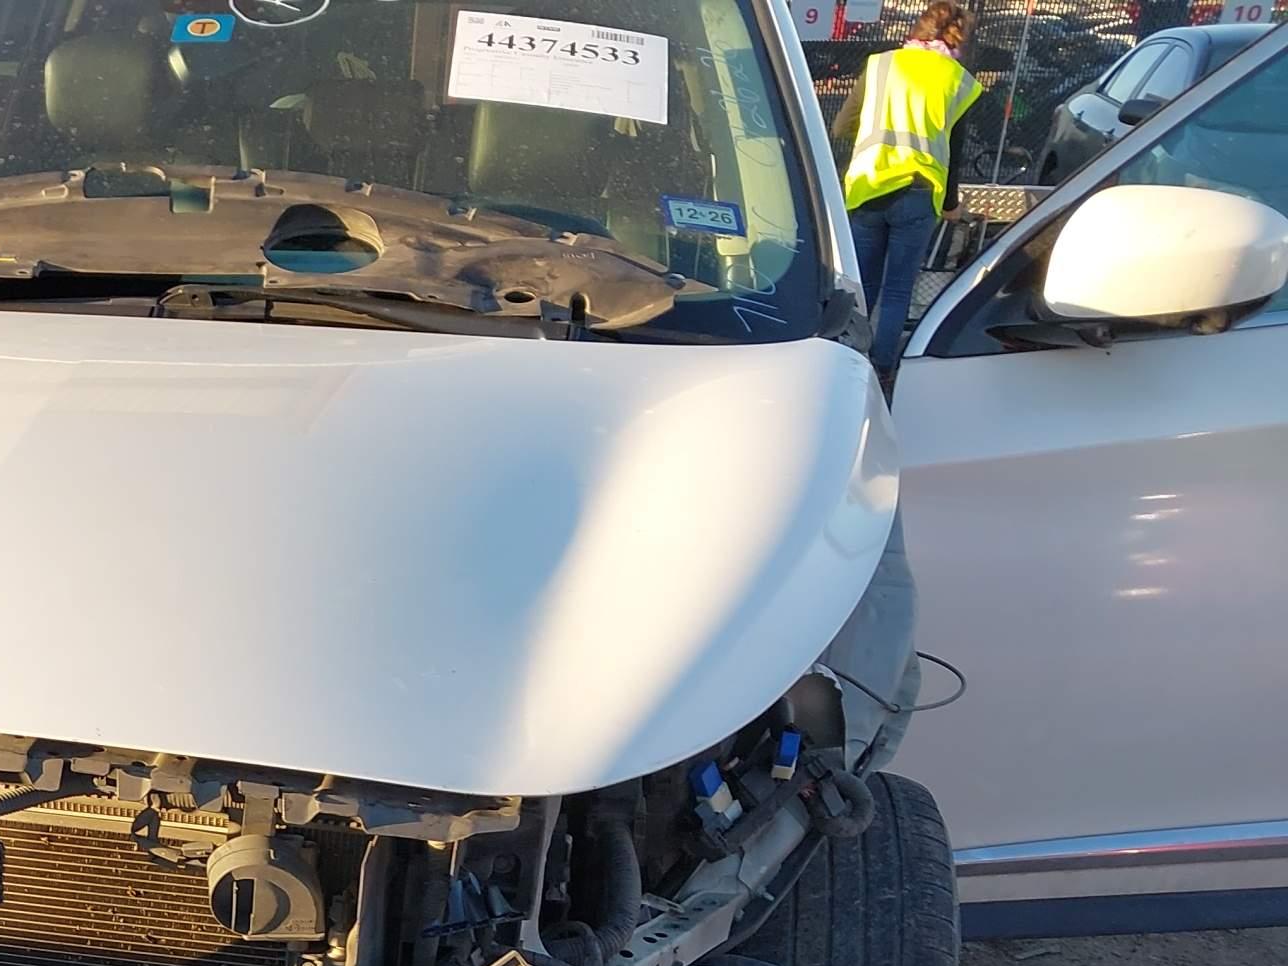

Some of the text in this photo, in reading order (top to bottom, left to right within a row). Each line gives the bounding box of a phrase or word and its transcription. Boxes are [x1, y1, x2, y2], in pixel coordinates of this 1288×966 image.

[805, 8, 819, 24] 9
[1233, 4, 1262, 22] 10
[477, 32, 641, 66] 44374533
